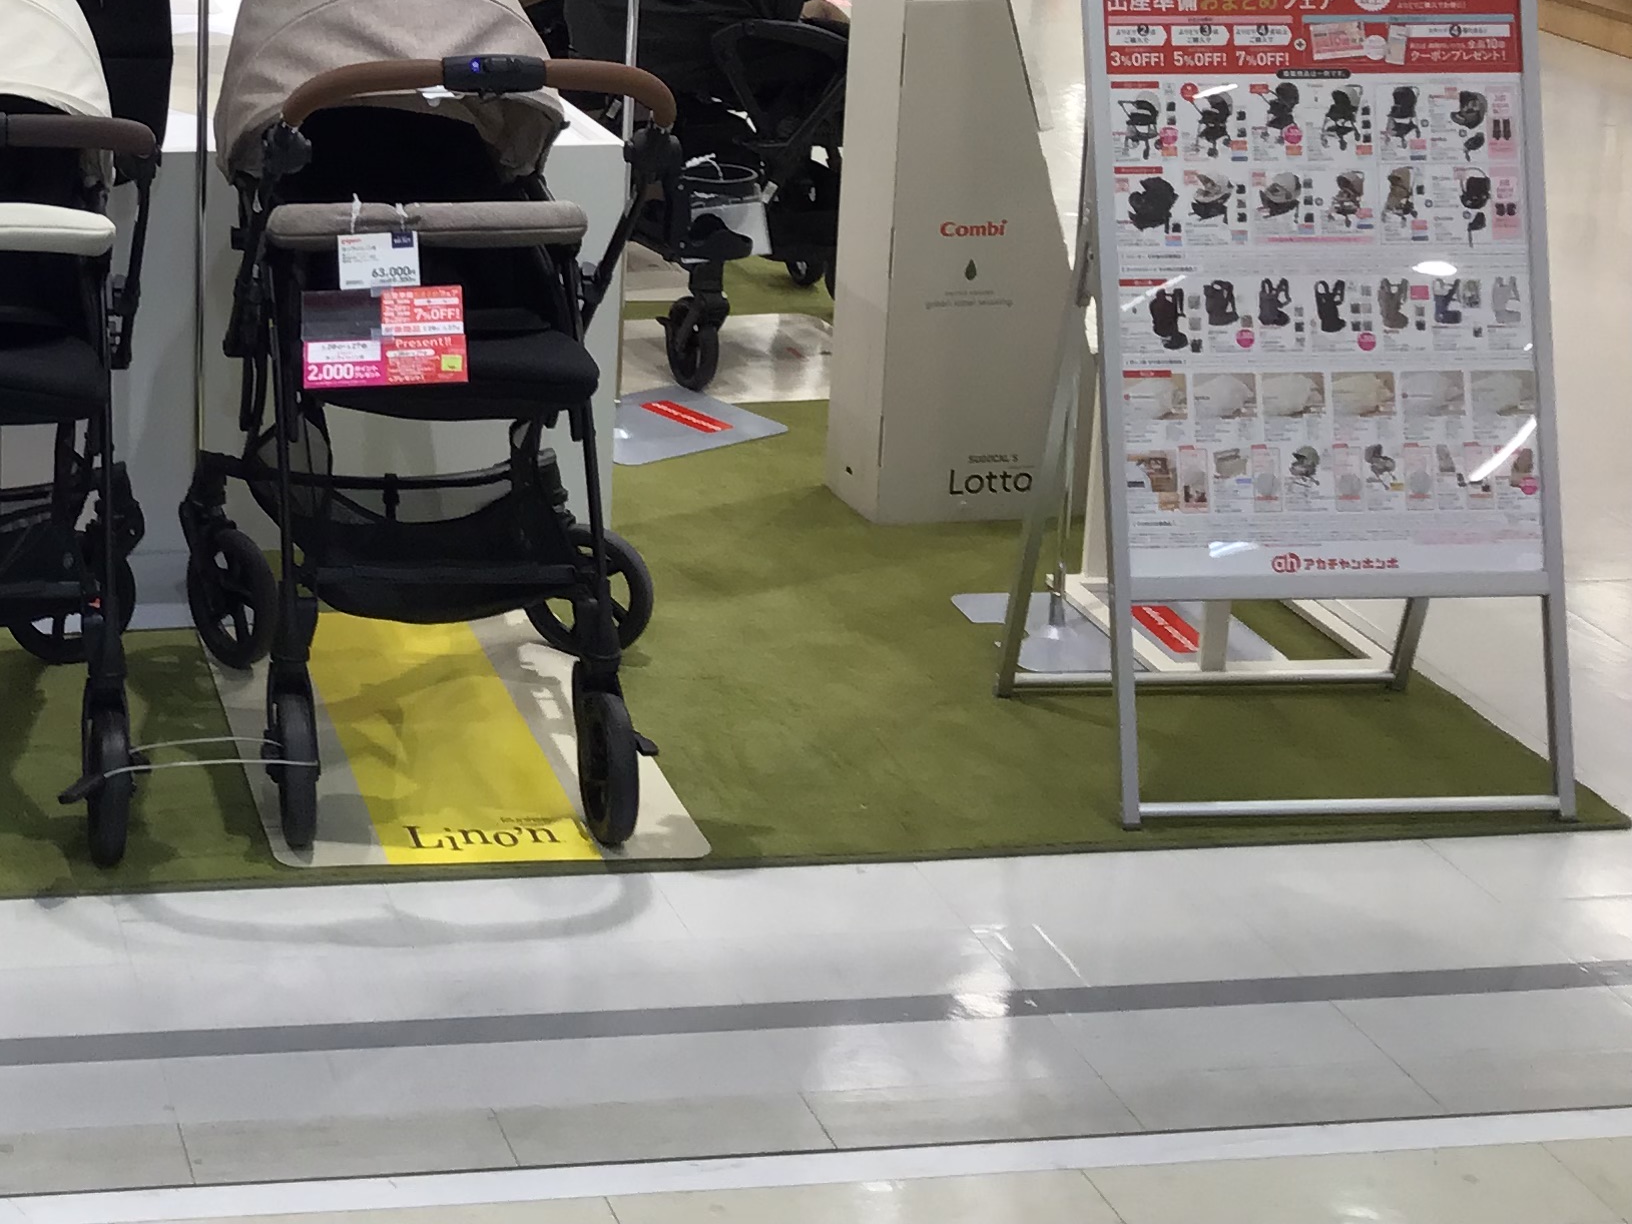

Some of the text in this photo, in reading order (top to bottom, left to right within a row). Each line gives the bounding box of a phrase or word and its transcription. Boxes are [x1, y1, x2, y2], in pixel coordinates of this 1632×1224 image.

[1110, 50, 1290, 67] 3%OFF! 5%OFF! 7%OFF!
[940, 219, 1008, 237] Combi
[949, 470, 1033, 495] Lotto
[1303, 557, 1400, 570] アカチャンホンポ
